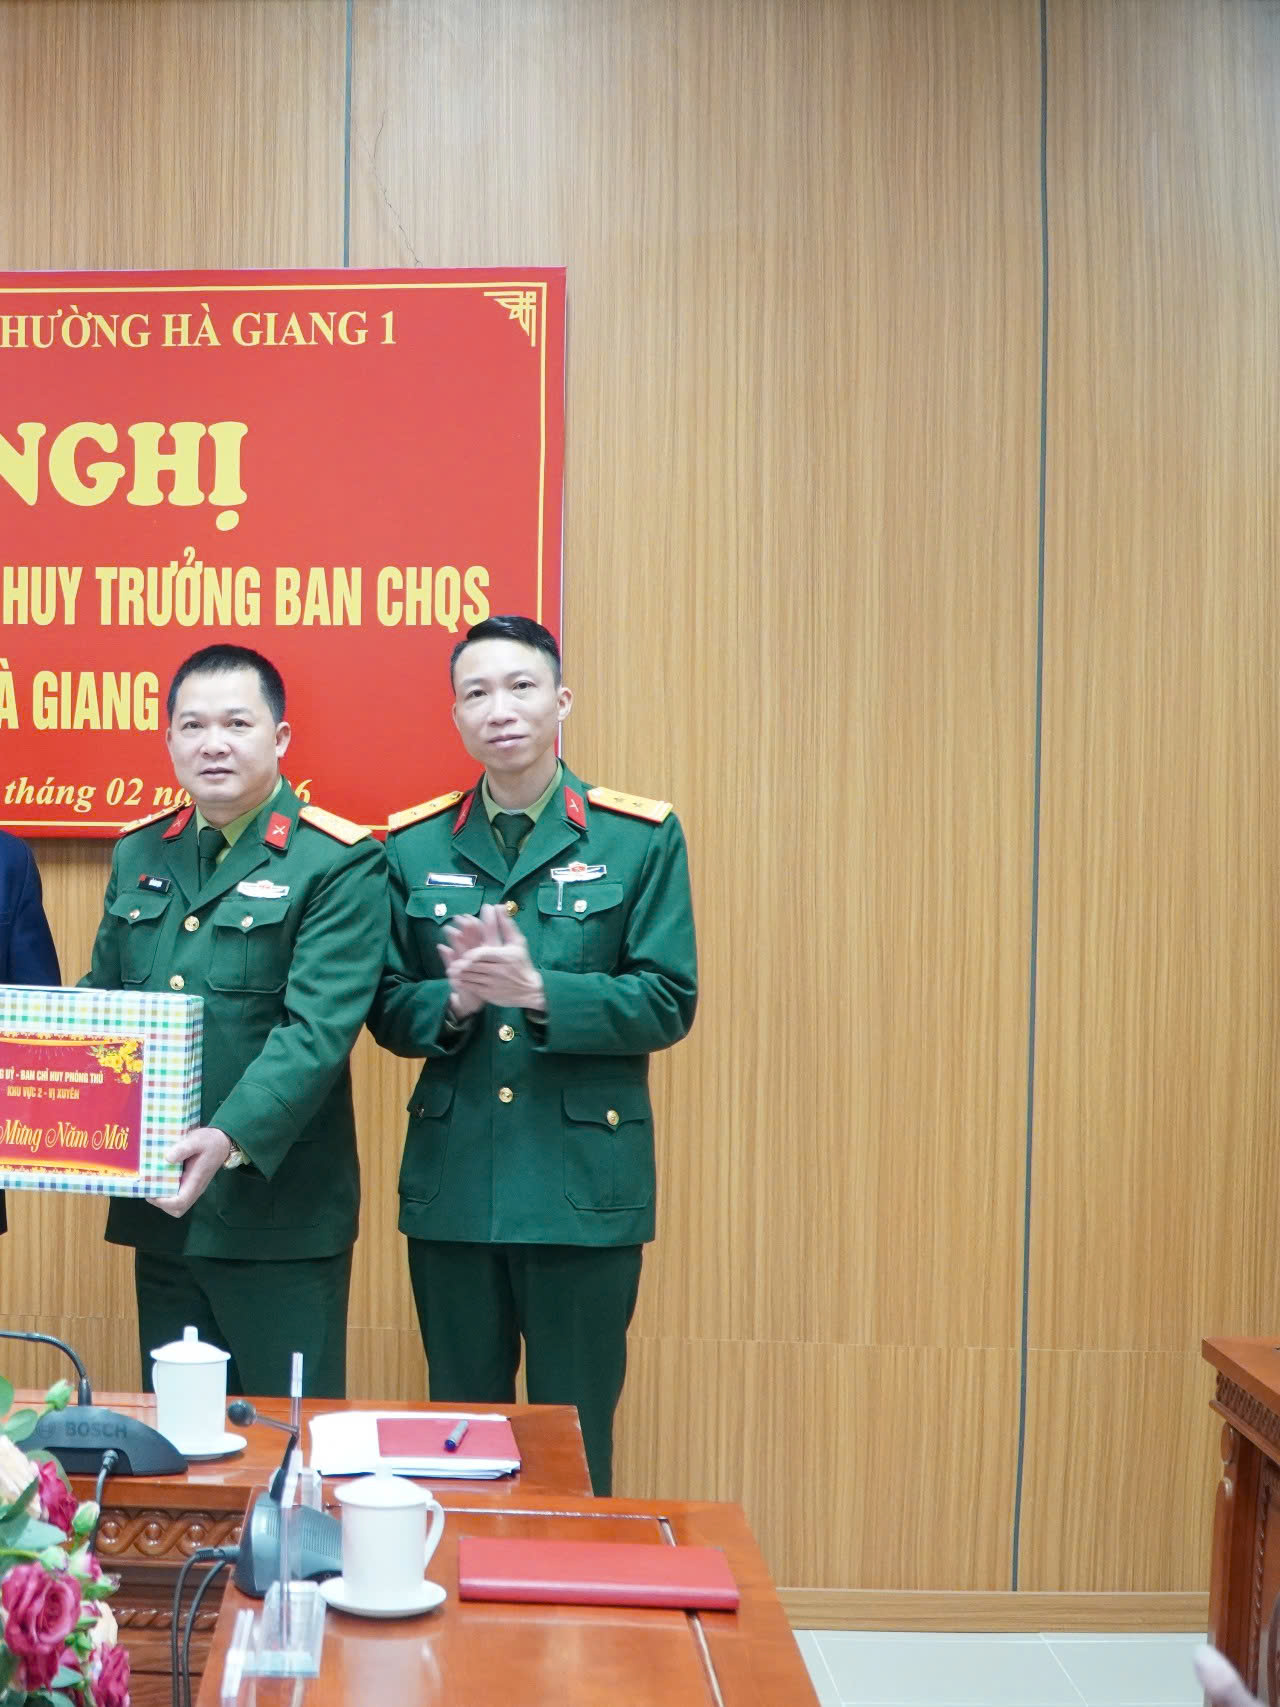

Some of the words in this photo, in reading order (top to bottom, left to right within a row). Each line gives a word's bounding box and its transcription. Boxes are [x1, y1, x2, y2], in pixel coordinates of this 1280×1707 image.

[161, 303, 222, 347] HÀ
[232, 311, 369, 347] GIANG
[381, 310, 397, 345] 1
[2, 566, 83, 626] HUY
[95, 546, 261, 627] TRƯỞNG
[275, 566, 362, 626] BAN
[376, 565, 490, 634] CHQS
[32, 670, 159, 731] GIANG
[4, 776, 97, 813] tháng
[106, 777, 144, 806] 02
[20, 1069, 36, 1081] BAN
[36, 1067, 49, 1082] CHỈ
[49, 1070, 64, 1082] HUY
[7, 1085, 22, 1097] KHU
[23, 1086, 36, 1099] VỰC
[37, 1087, 43, 1098] 2
[45, 1121, 89, 1149] Năm
[91, 1123, 130, 1151] Mới
[64, 1421, 128, 1439] BOSCH
